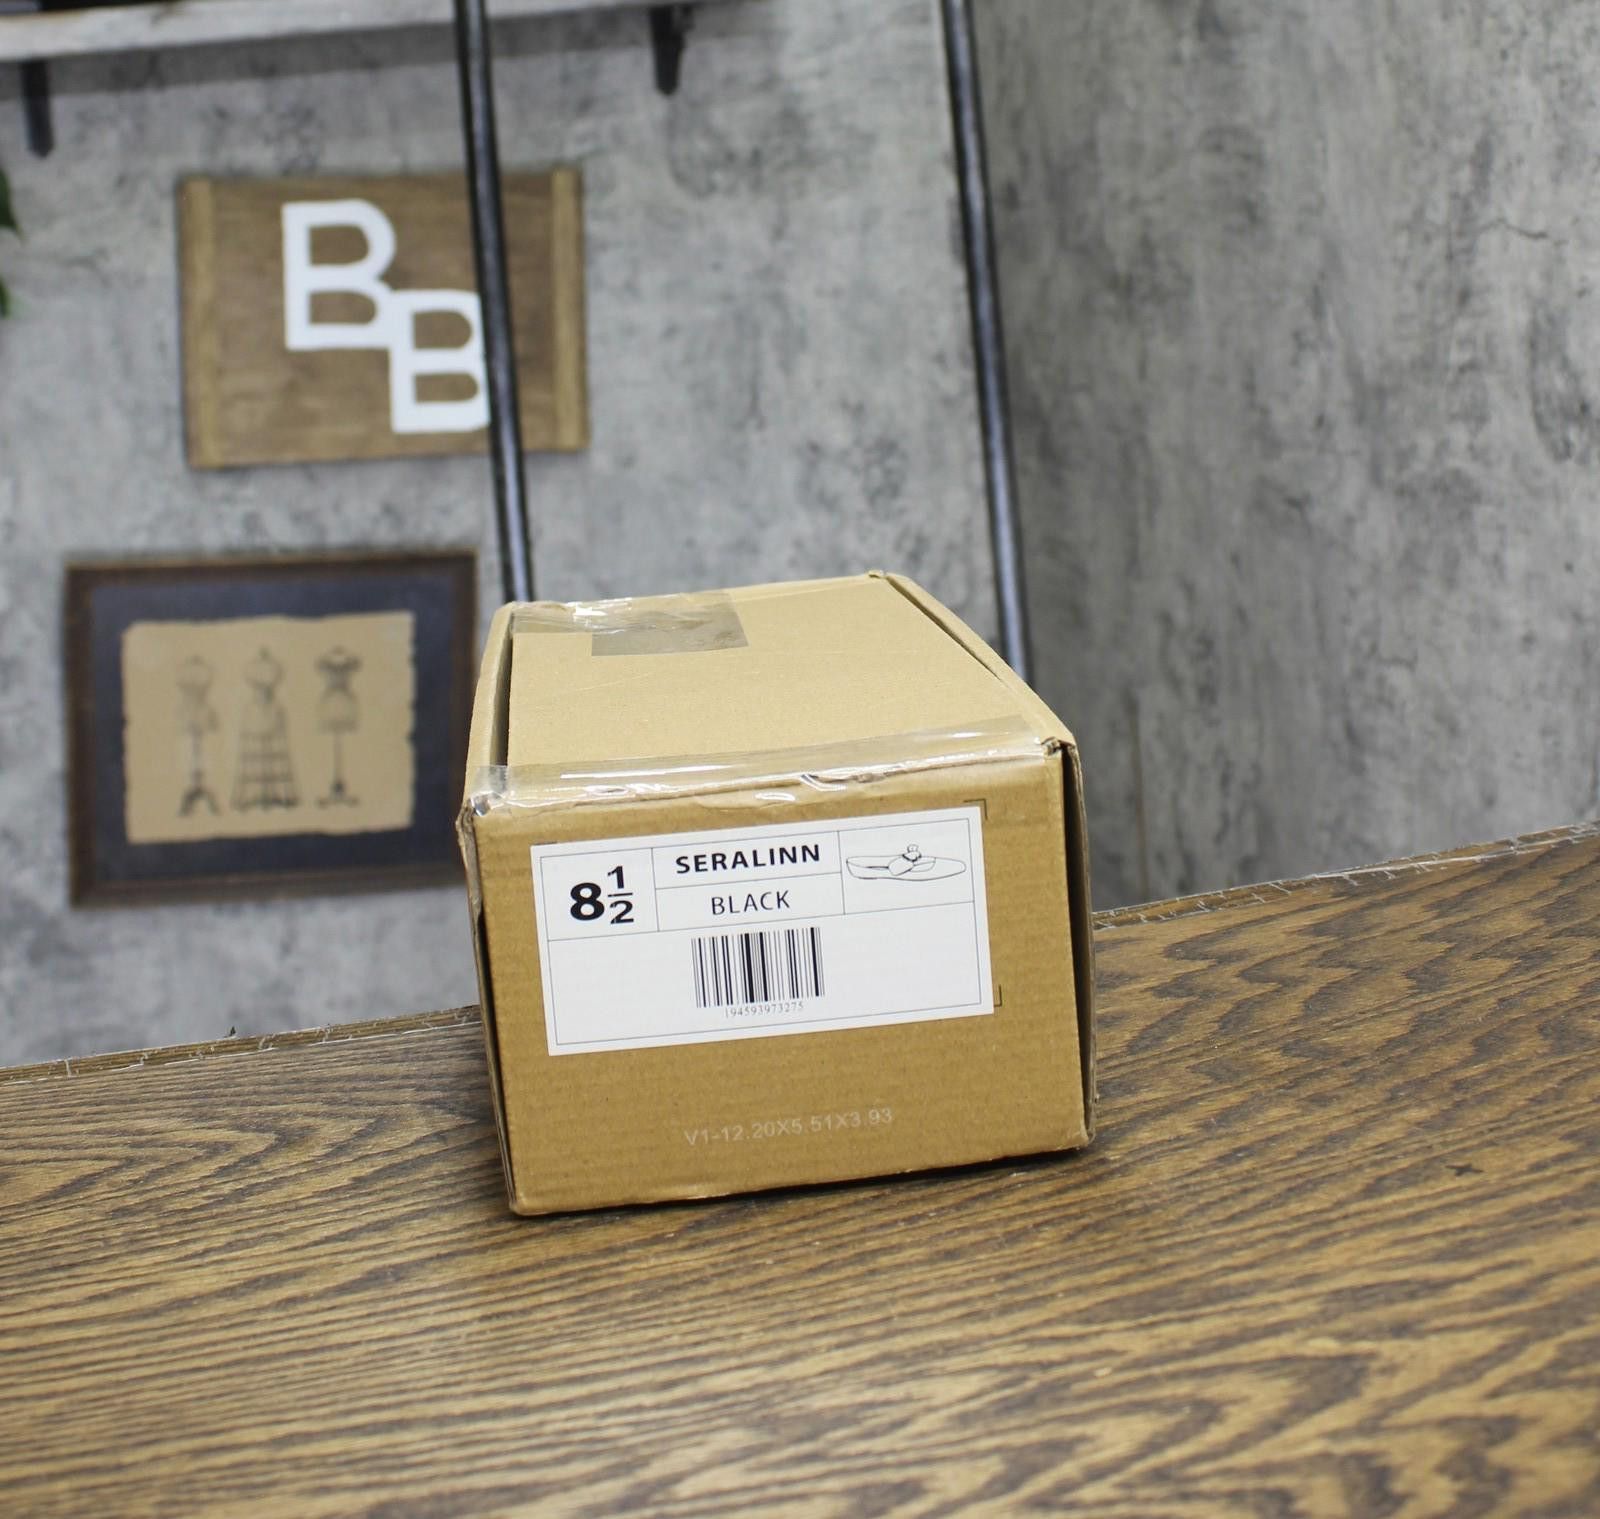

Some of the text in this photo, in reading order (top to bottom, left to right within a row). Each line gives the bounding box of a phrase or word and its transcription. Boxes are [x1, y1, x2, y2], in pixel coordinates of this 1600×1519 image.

[675, 844, 821, 874] SERALINN
[711, 890, 791, 916] BLACK
[724, 1001, 804, 1018] 194593973275
